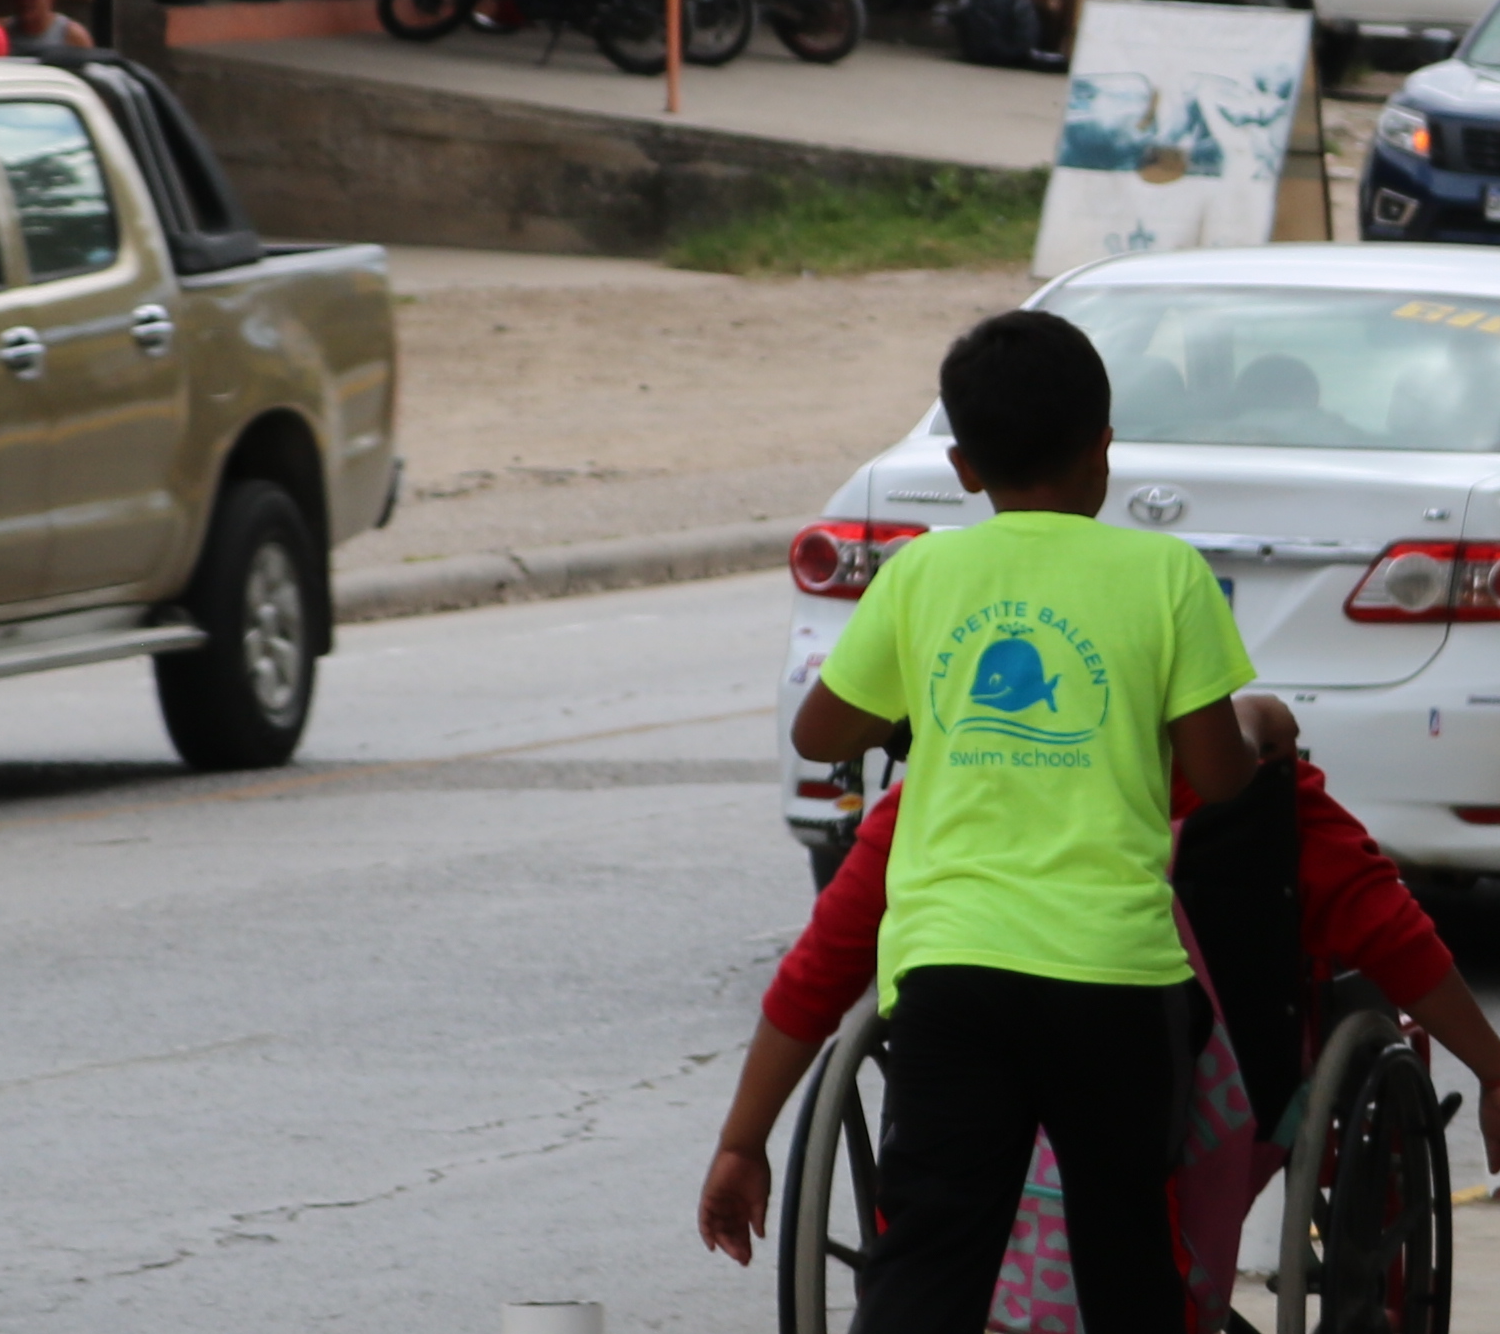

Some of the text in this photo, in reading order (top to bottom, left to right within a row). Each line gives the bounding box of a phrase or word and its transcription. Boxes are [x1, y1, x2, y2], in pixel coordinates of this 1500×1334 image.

[932, 600, 1109, 686] LA PETITE BALEEN
[950, 747, 1092, 768] swim schools
